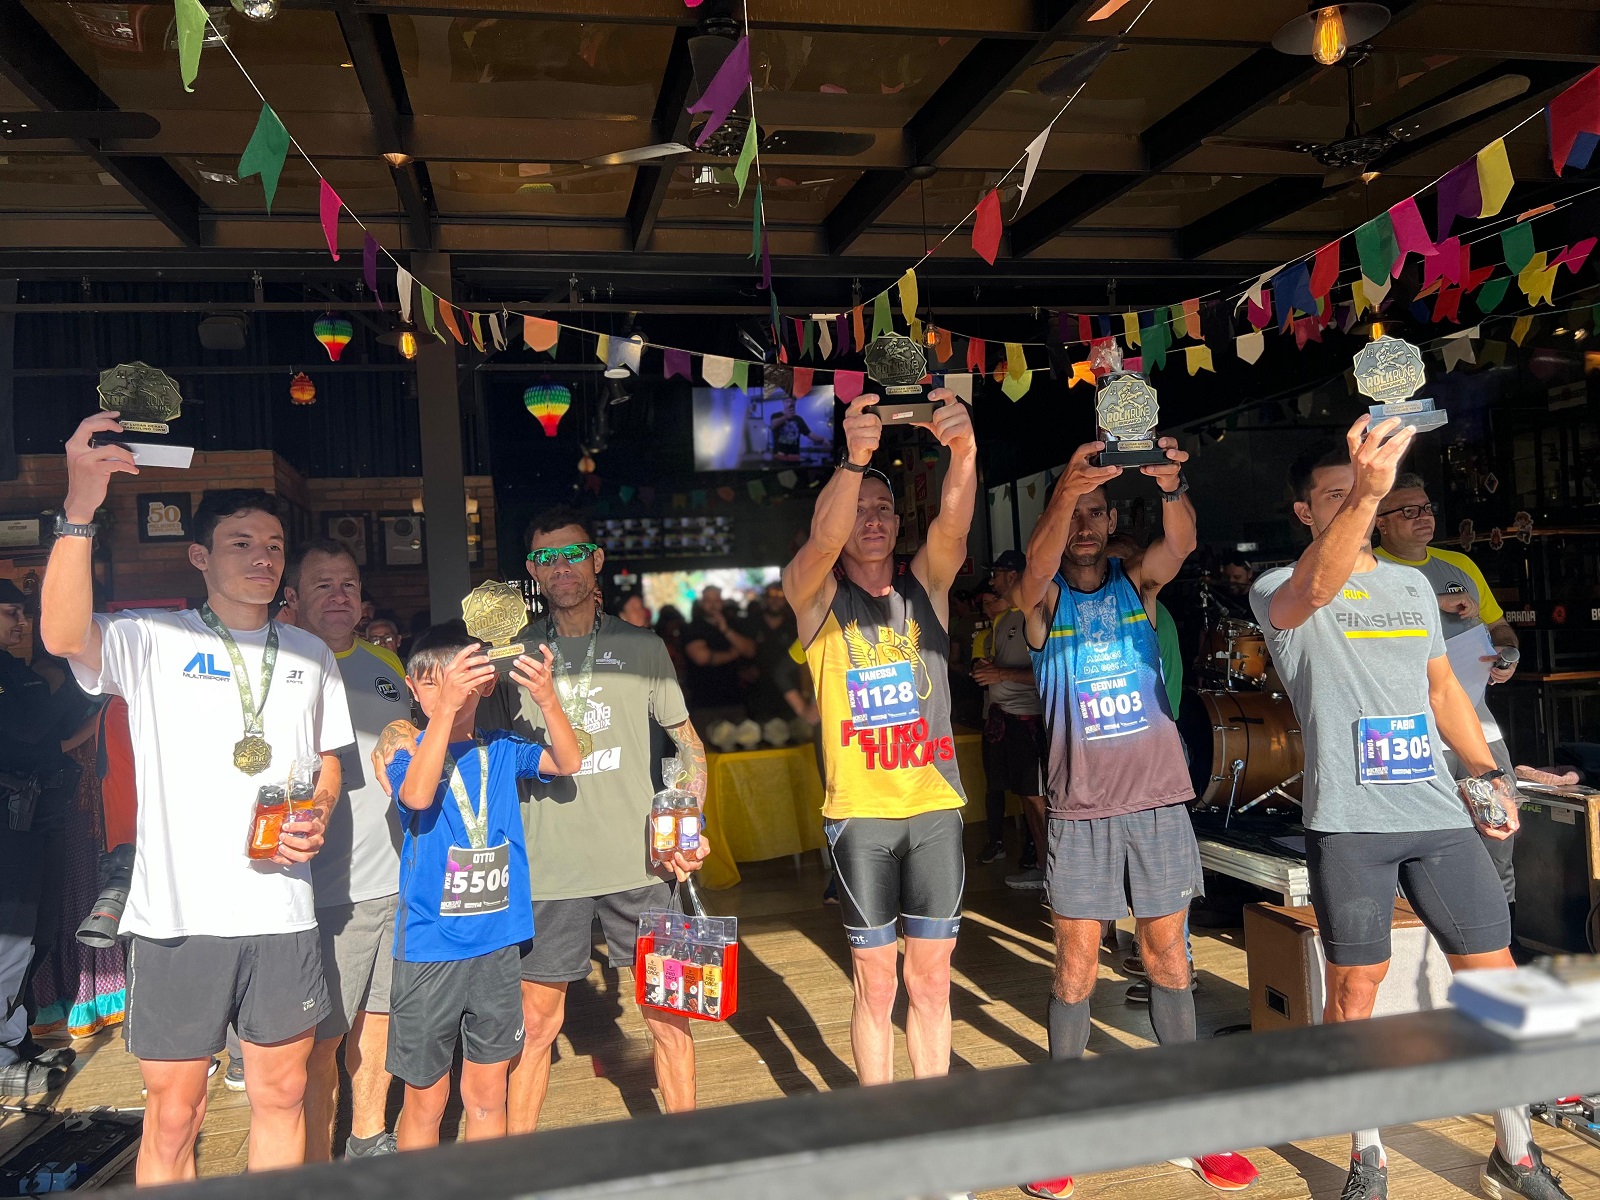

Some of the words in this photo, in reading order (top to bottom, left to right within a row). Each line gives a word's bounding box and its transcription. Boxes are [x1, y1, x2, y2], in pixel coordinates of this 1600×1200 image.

[149, 506, 180, 523] 50
[1343, 589, 1370, 600] RUN
[1336, 611, 1425, 628] FINISHER
[182, 672, 230, 682] MULTISPORT
[858, 667, 898, 681] VANESSA
[1083, 665, 1099, 675] DA
[1090, 678, 1127, 692] GEOVANI
[857, 681, 914, 709] 1128
[1087, 691, 1142, 719] 1003
[841, 717, 929, 747] PETRO
[861, 735, 954, 770] TUKA'S
[1366, 739, 1375, 759] 10KM
[1376, 735, 1431, 760] 1305
[472, 852, 495, 864] OTTO
[444, 872, 452, 890] 5KM
[451, 864, 509, 893] 5506
